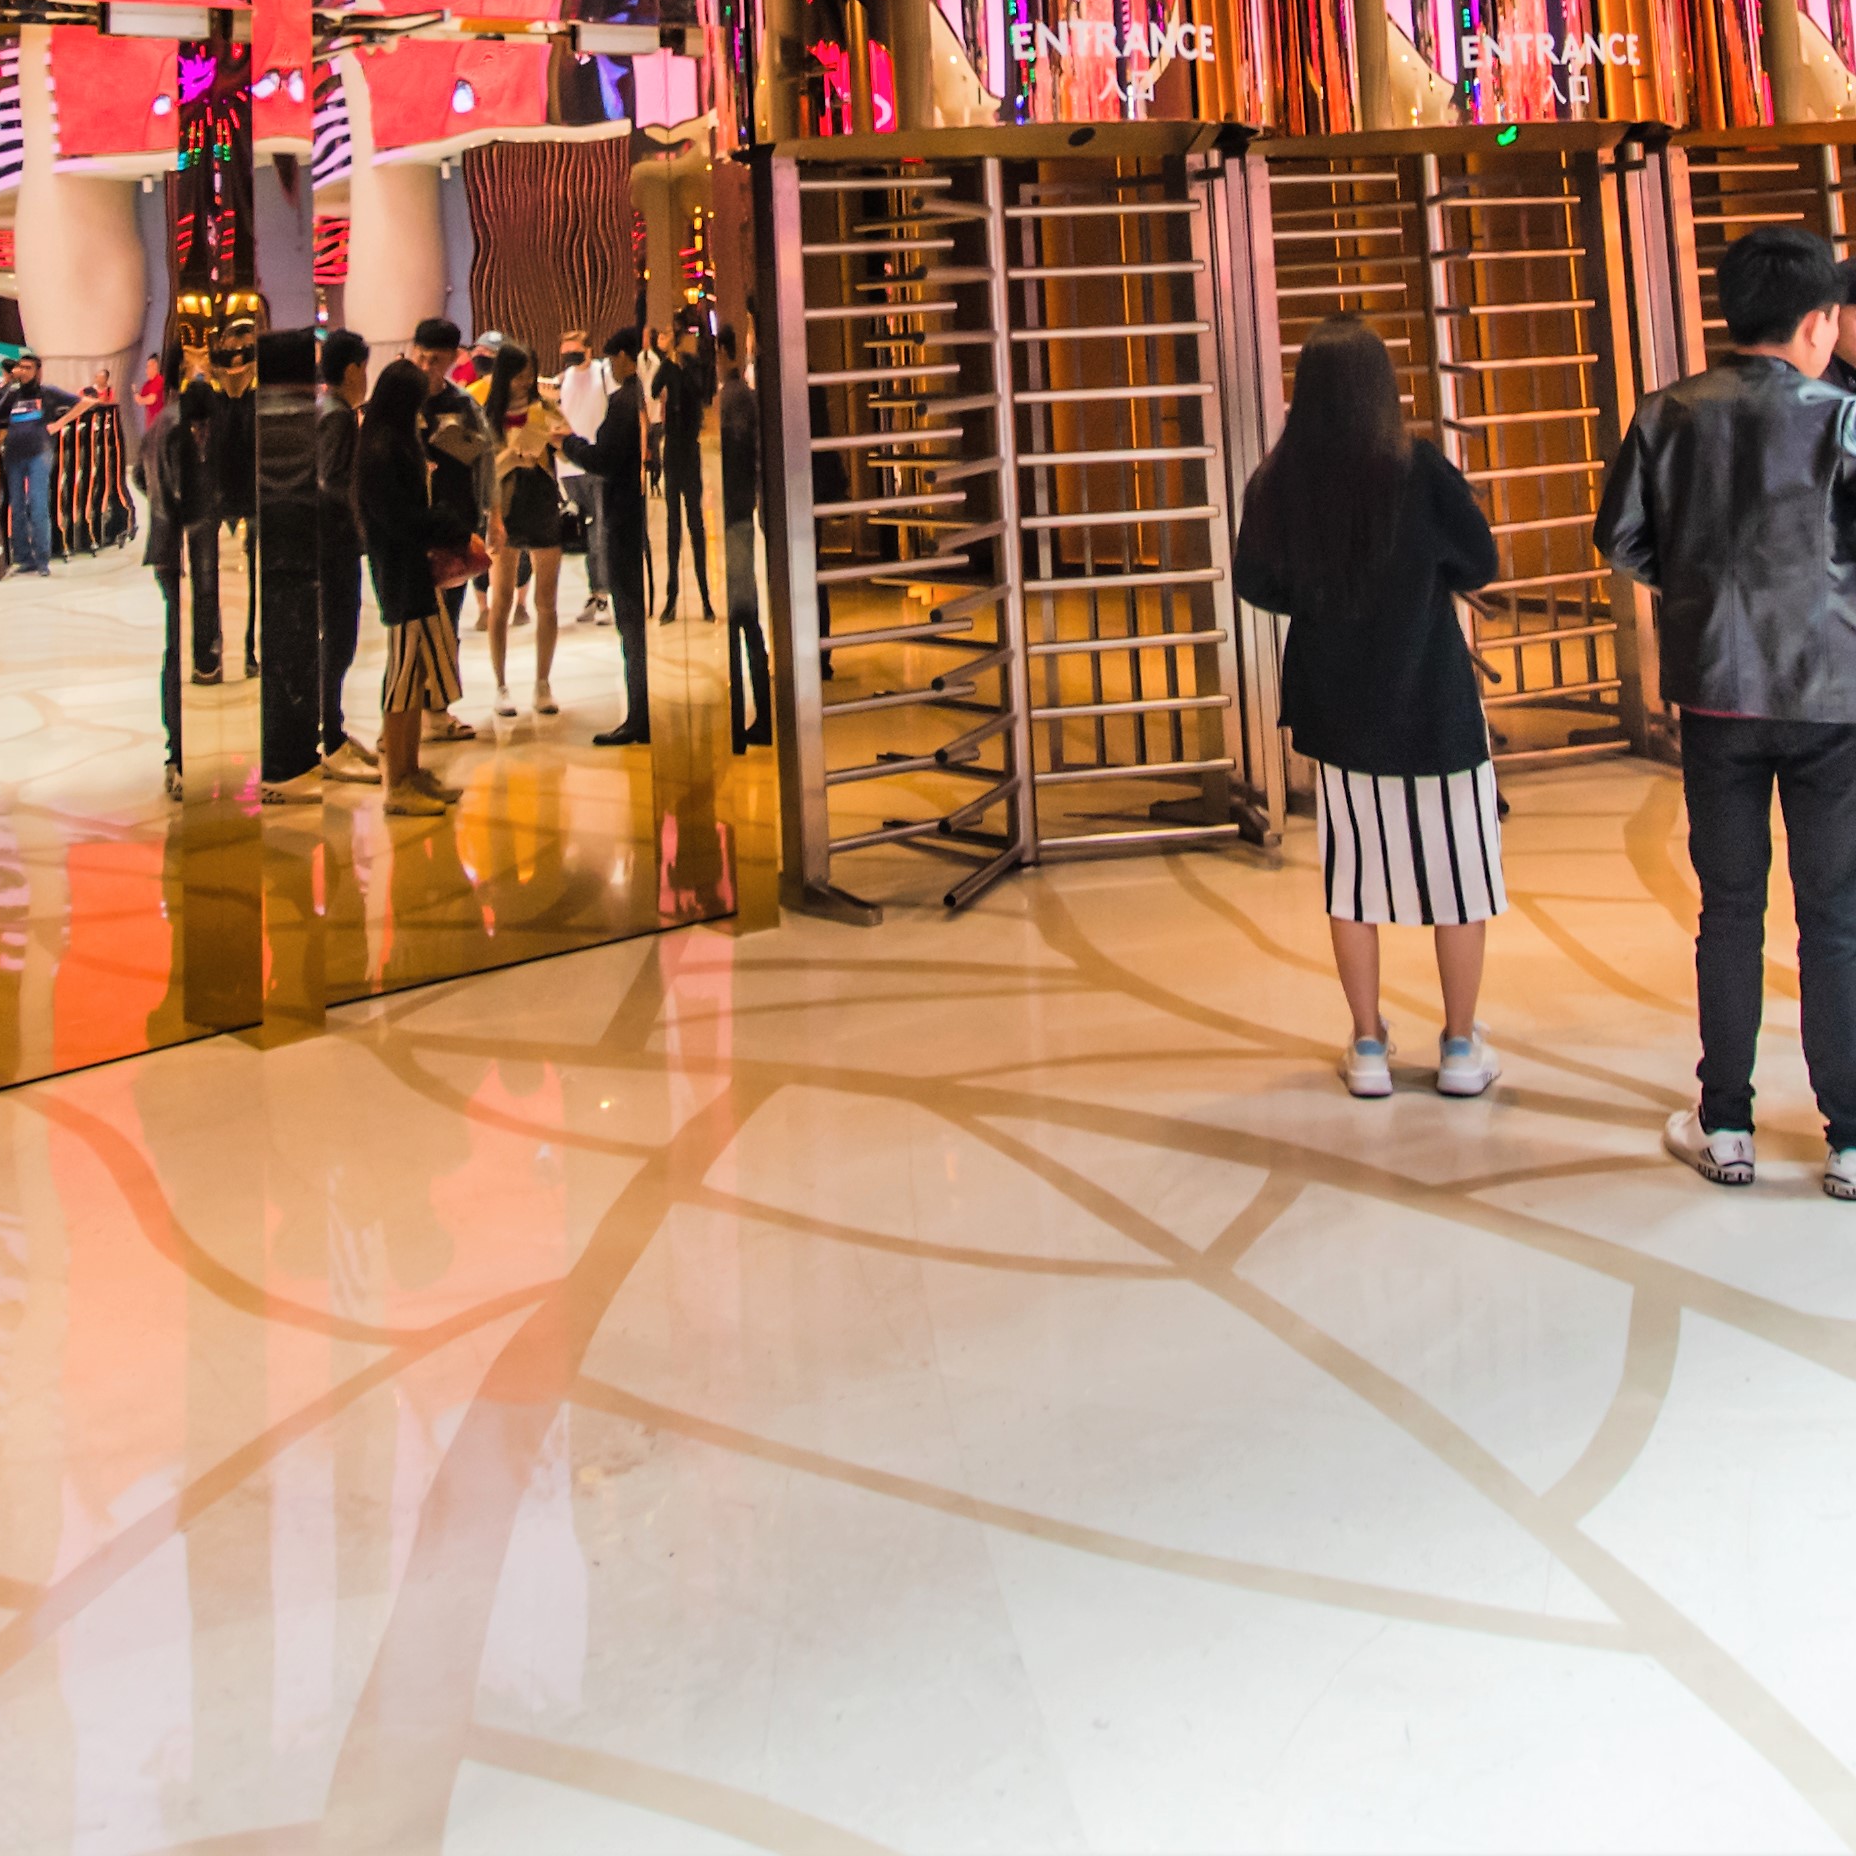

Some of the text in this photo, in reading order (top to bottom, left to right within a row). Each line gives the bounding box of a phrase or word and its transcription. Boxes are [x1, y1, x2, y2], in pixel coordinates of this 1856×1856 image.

[1011, 20, 1215, 62] ENTRANCE
[1461, 32, 1641, 69] ENTRANCE
[1098, 68, 1155, 103] 入口
[1543, 75, 1591, 105] 入口
